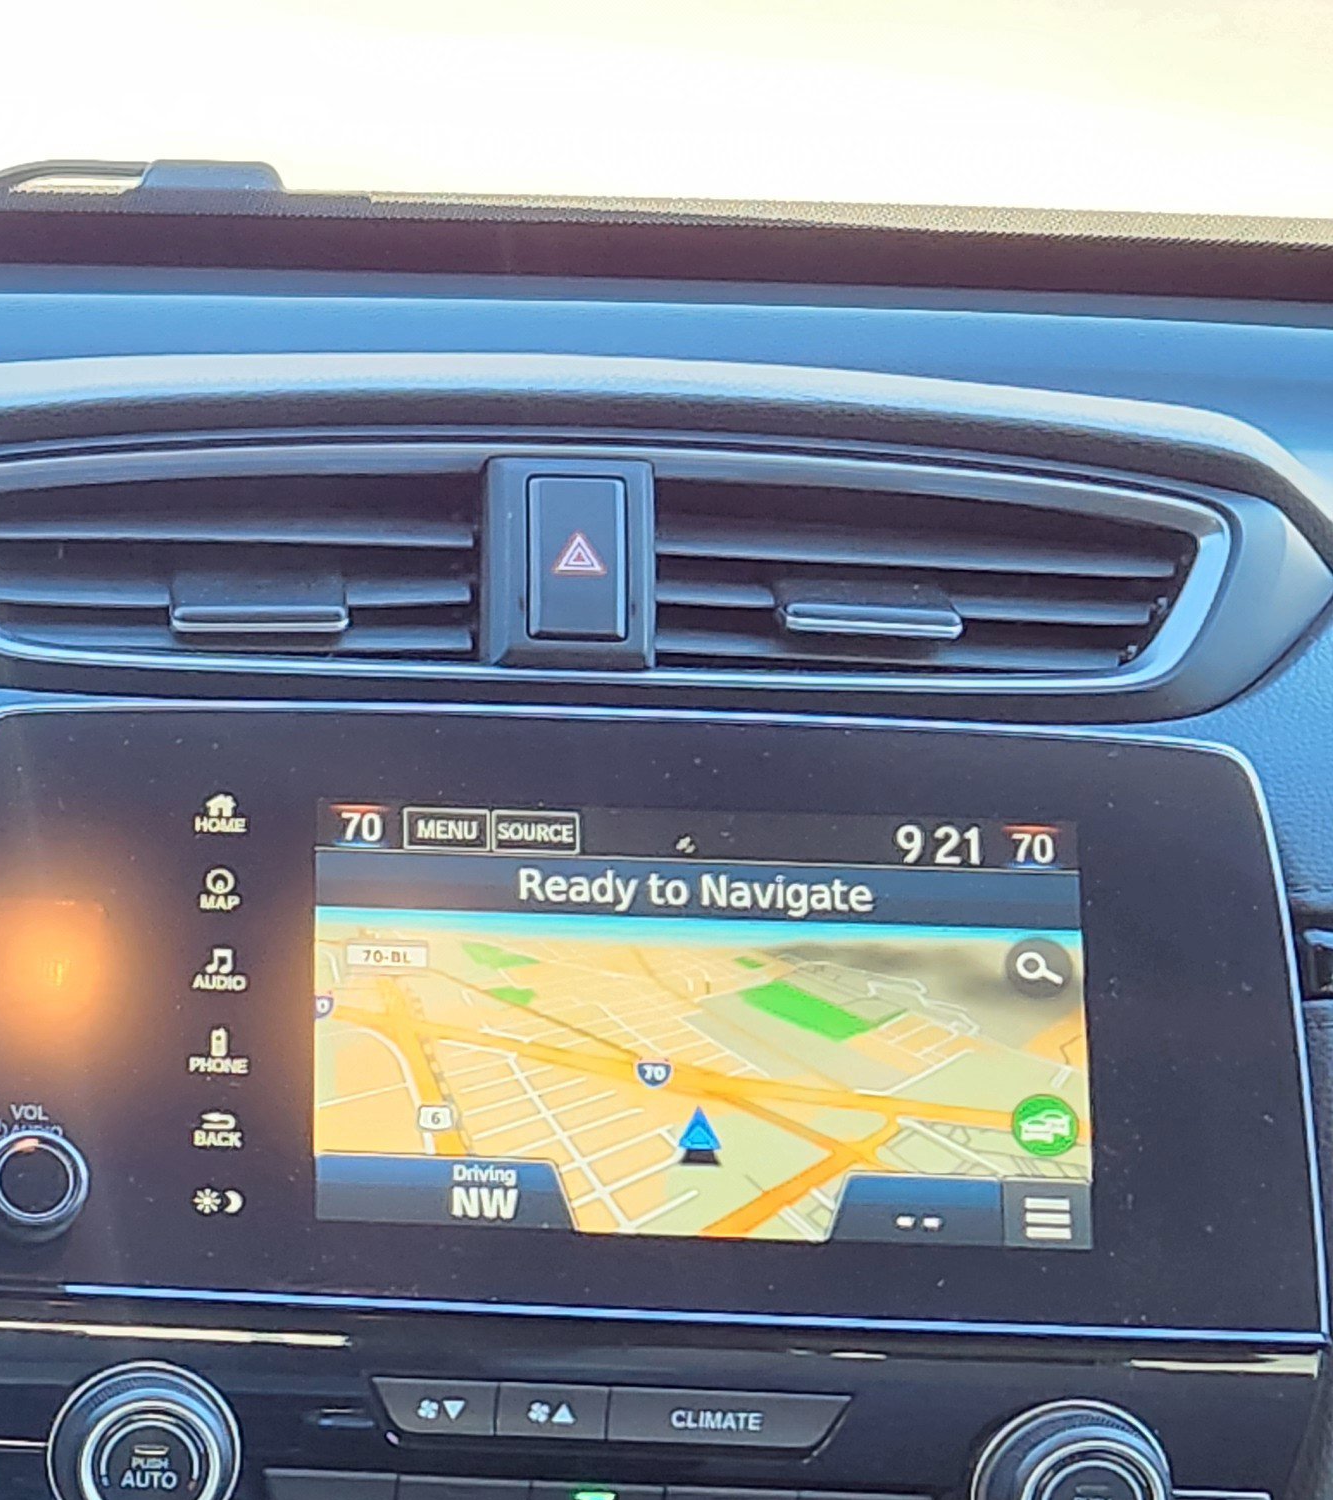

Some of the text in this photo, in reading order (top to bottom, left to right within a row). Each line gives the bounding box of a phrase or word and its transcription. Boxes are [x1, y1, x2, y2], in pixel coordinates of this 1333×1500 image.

[195, 816, 247, 833] HOME
[341, 813, 384, 842] 70
[416, 819, 479, 841] MENU
[497, 822, 575, 845] SOURCE
[1011, 832, 1055, 864] 70
[199, 894, 240, 911] MAP
[518, 868, 875, 918] Ready to Navigate
[362, 949, 411, 965] 70-BL
[192, 975, 246, 992] AUDIO
[189, 1056, 248, 1075] PHONE
[642, 1064, 668, 1081] 70
[10, 1104, 50, 1121] VOL
[429, 1110, 442, 1126] 6
[193, 1130, 242, 1148] BACK
[452, 1164, 518, 1185] Driving
[452, 1186, 520, 1220] NW
[670, 1410, 764, 1433] CLIMATE
[131, 1456, 169, 1470] PUSH
[120, 1469, 178, 1490] AUTO
